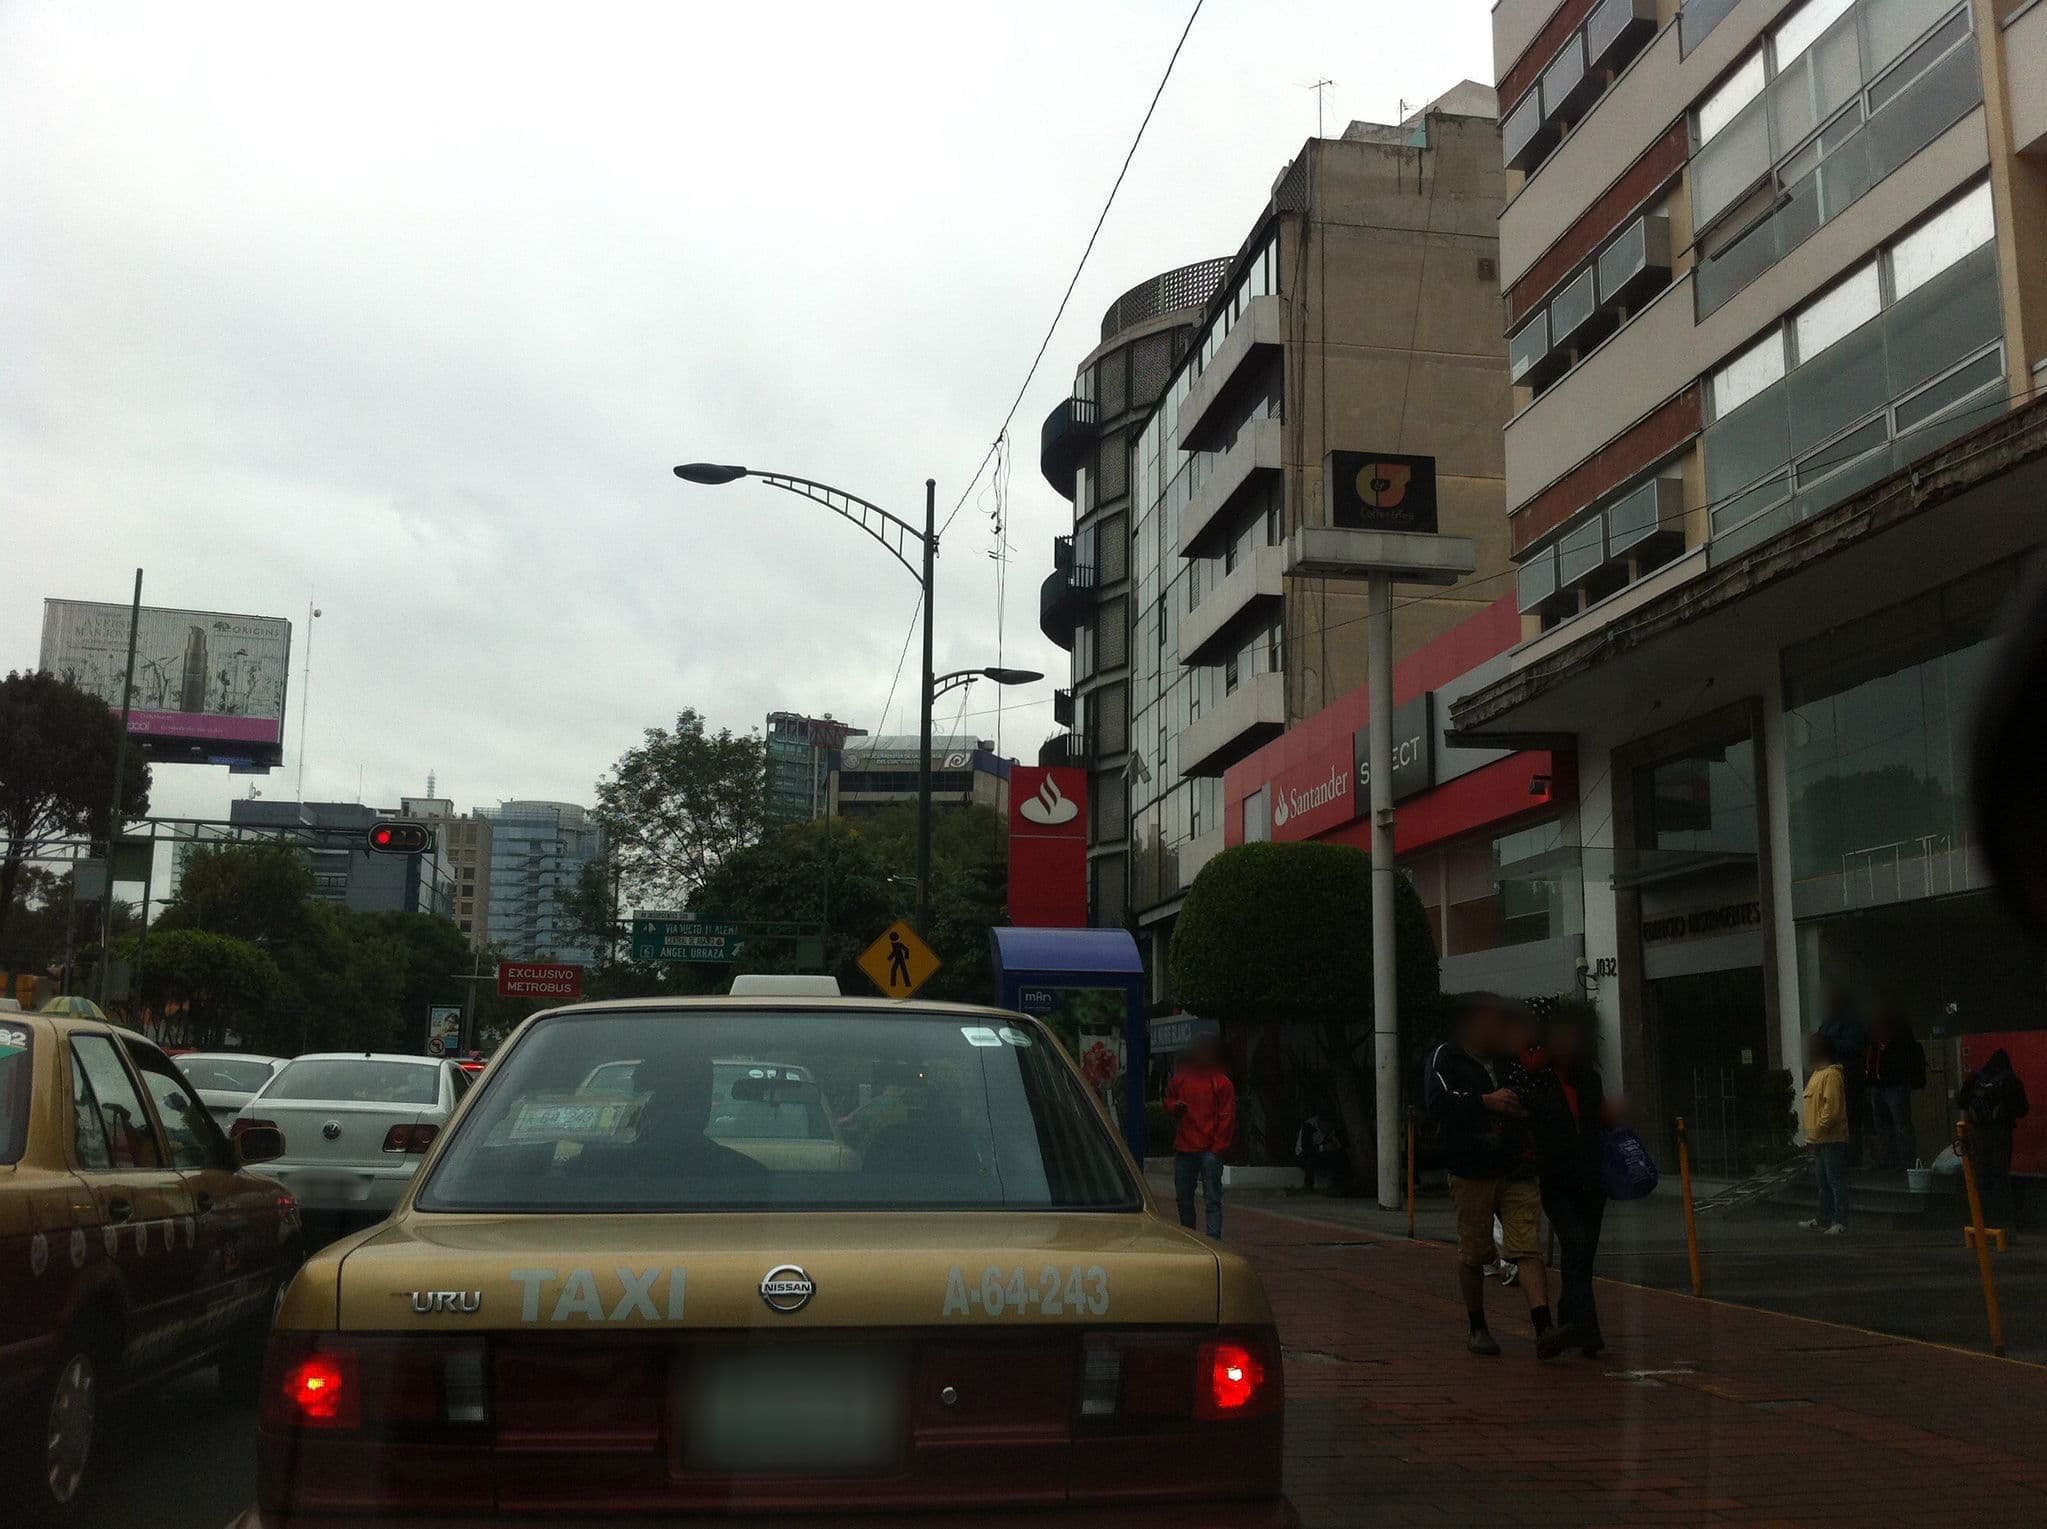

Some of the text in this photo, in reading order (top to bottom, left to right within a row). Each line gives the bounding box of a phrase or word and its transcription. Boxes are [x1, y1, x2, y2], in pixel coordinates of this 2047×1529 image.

[232, 626, 280, 637] ORIGINS
[1360, 735, 1420, 785] SECT
[1290, 765, 1348, 819] Santander
[659, 947, 725, 959] ANGEL URRAZA
[508, 968, 574, 980] EXCLUSIVO
[1596, 958, 1617, 977] 1032
[507, 981, 572, 993] METROBUS
[509, 1266, 688, 1322] TAXI
[763, 1281, 812, 1293] NISSAN
[942, 1264, 1110, 1317] A-64-243
[411, 1291, 482, 1314] URU
